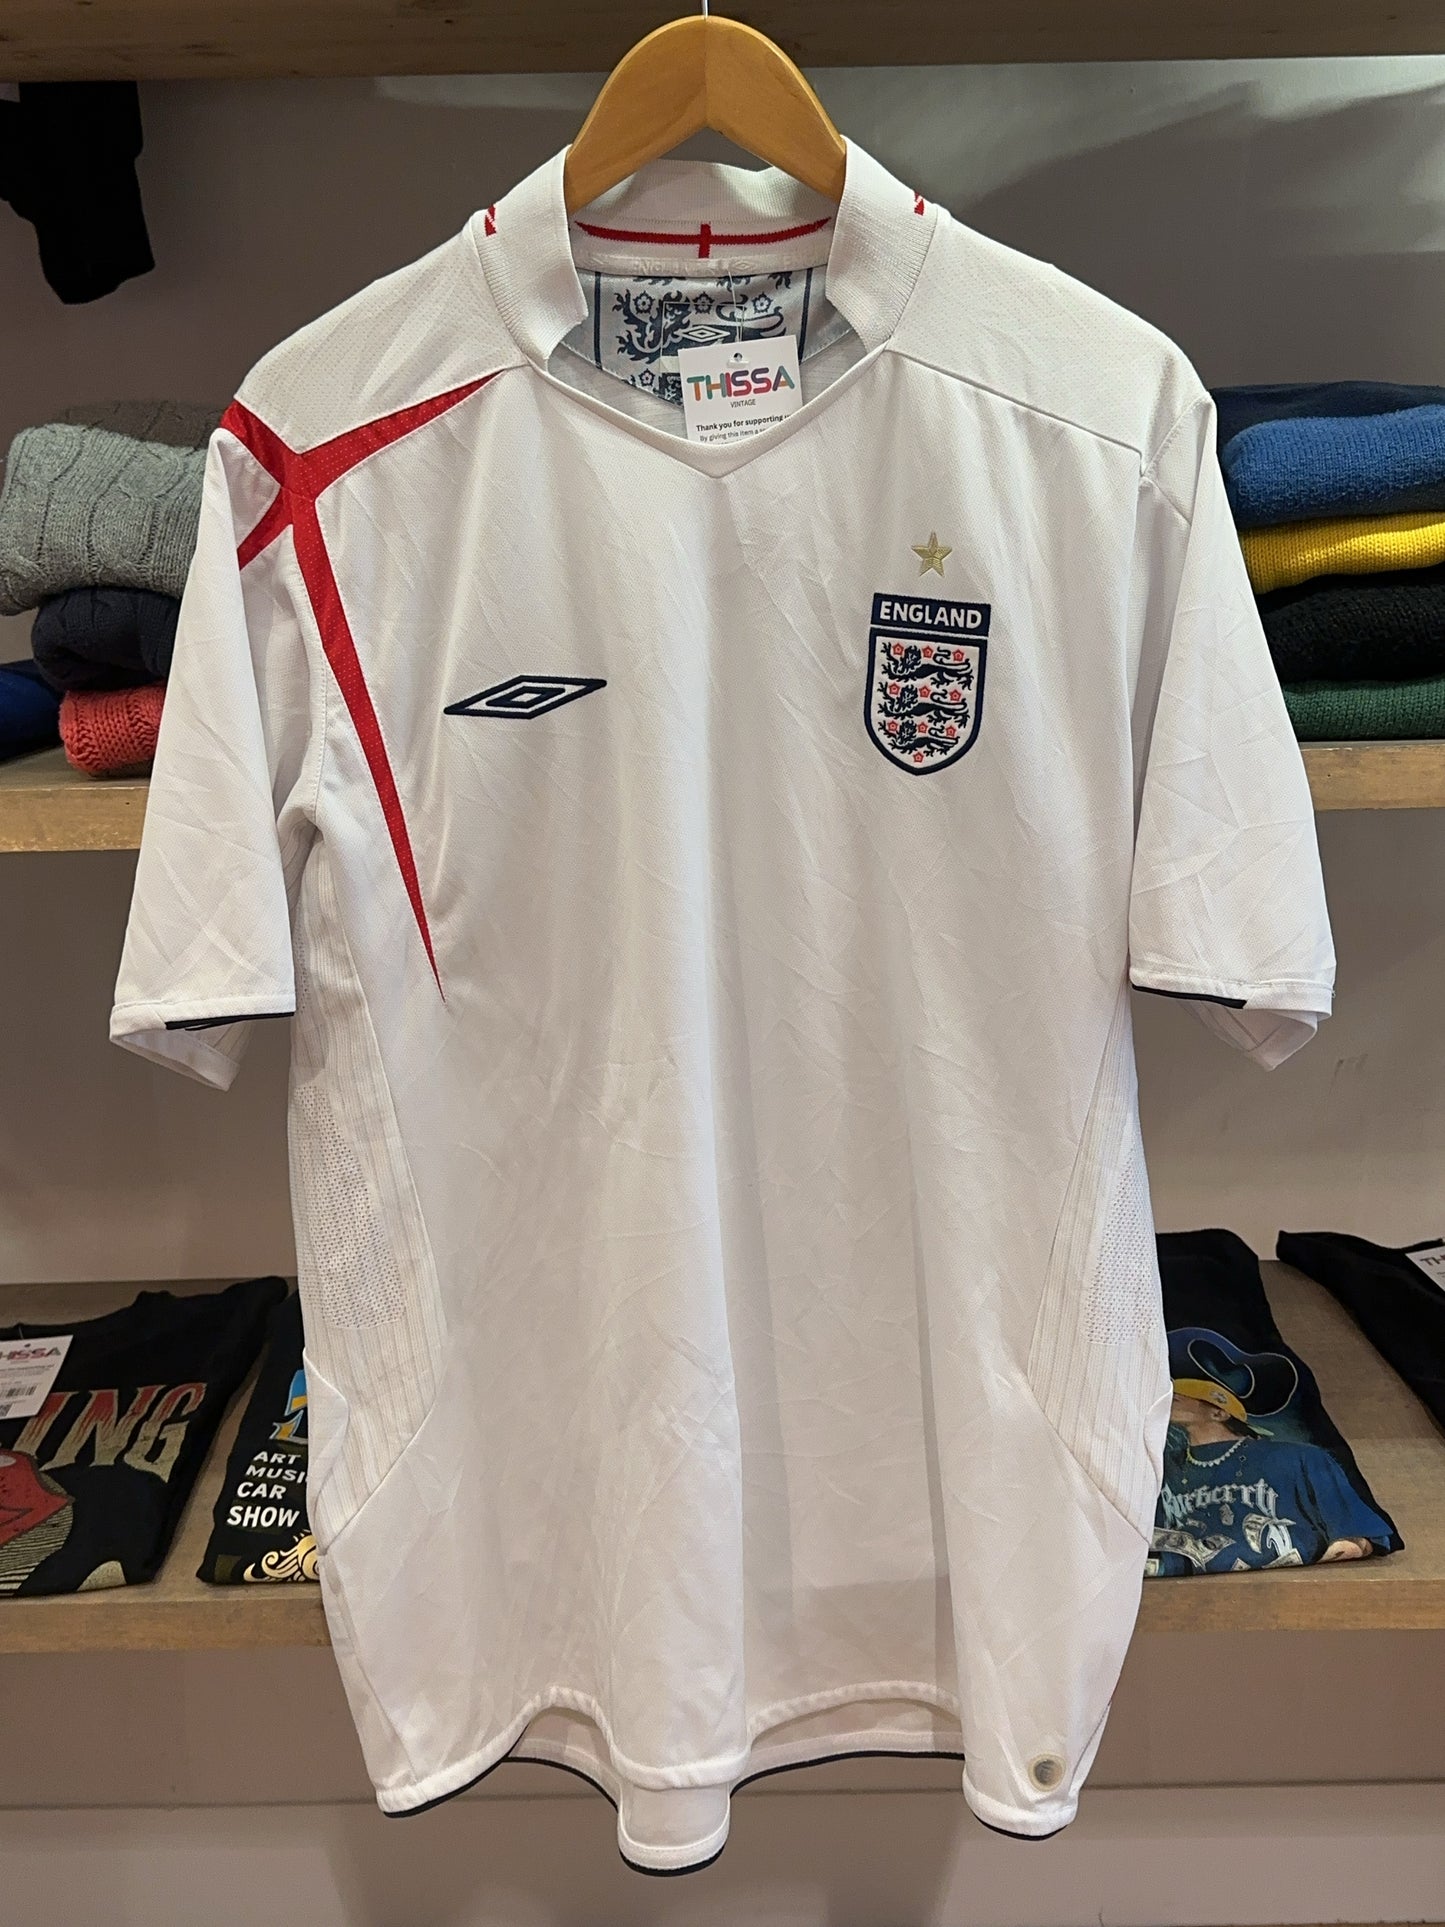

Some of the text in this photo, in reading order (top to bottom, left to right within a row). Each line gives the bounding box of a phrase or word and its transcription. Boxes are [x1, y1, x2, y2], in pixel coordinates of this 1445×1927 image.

[687, 366, 795, 401] THISSA
[730, 399, 756, 408] VINTAGE
[696, 422, 718, 431] Thank
[719, 421, 732, 430] you
[733, 417, 744, 426] for
[745, 414, 783, 426] supporting
[700, 434, 708, 442] By
[709, 432, 727, 441] giving
[879, 600, 982, 629] ENGLAND
[0, 1346, 61, 1361] HISSA
[13, 1382, 208, 1484] ING
[253, 1451, 301, 1465] ART
[245, 1464, 308, 1484] MUSI
[236, 1481, 287, 1500] CAR
[226, 1505, 300, 1528] SHOW
